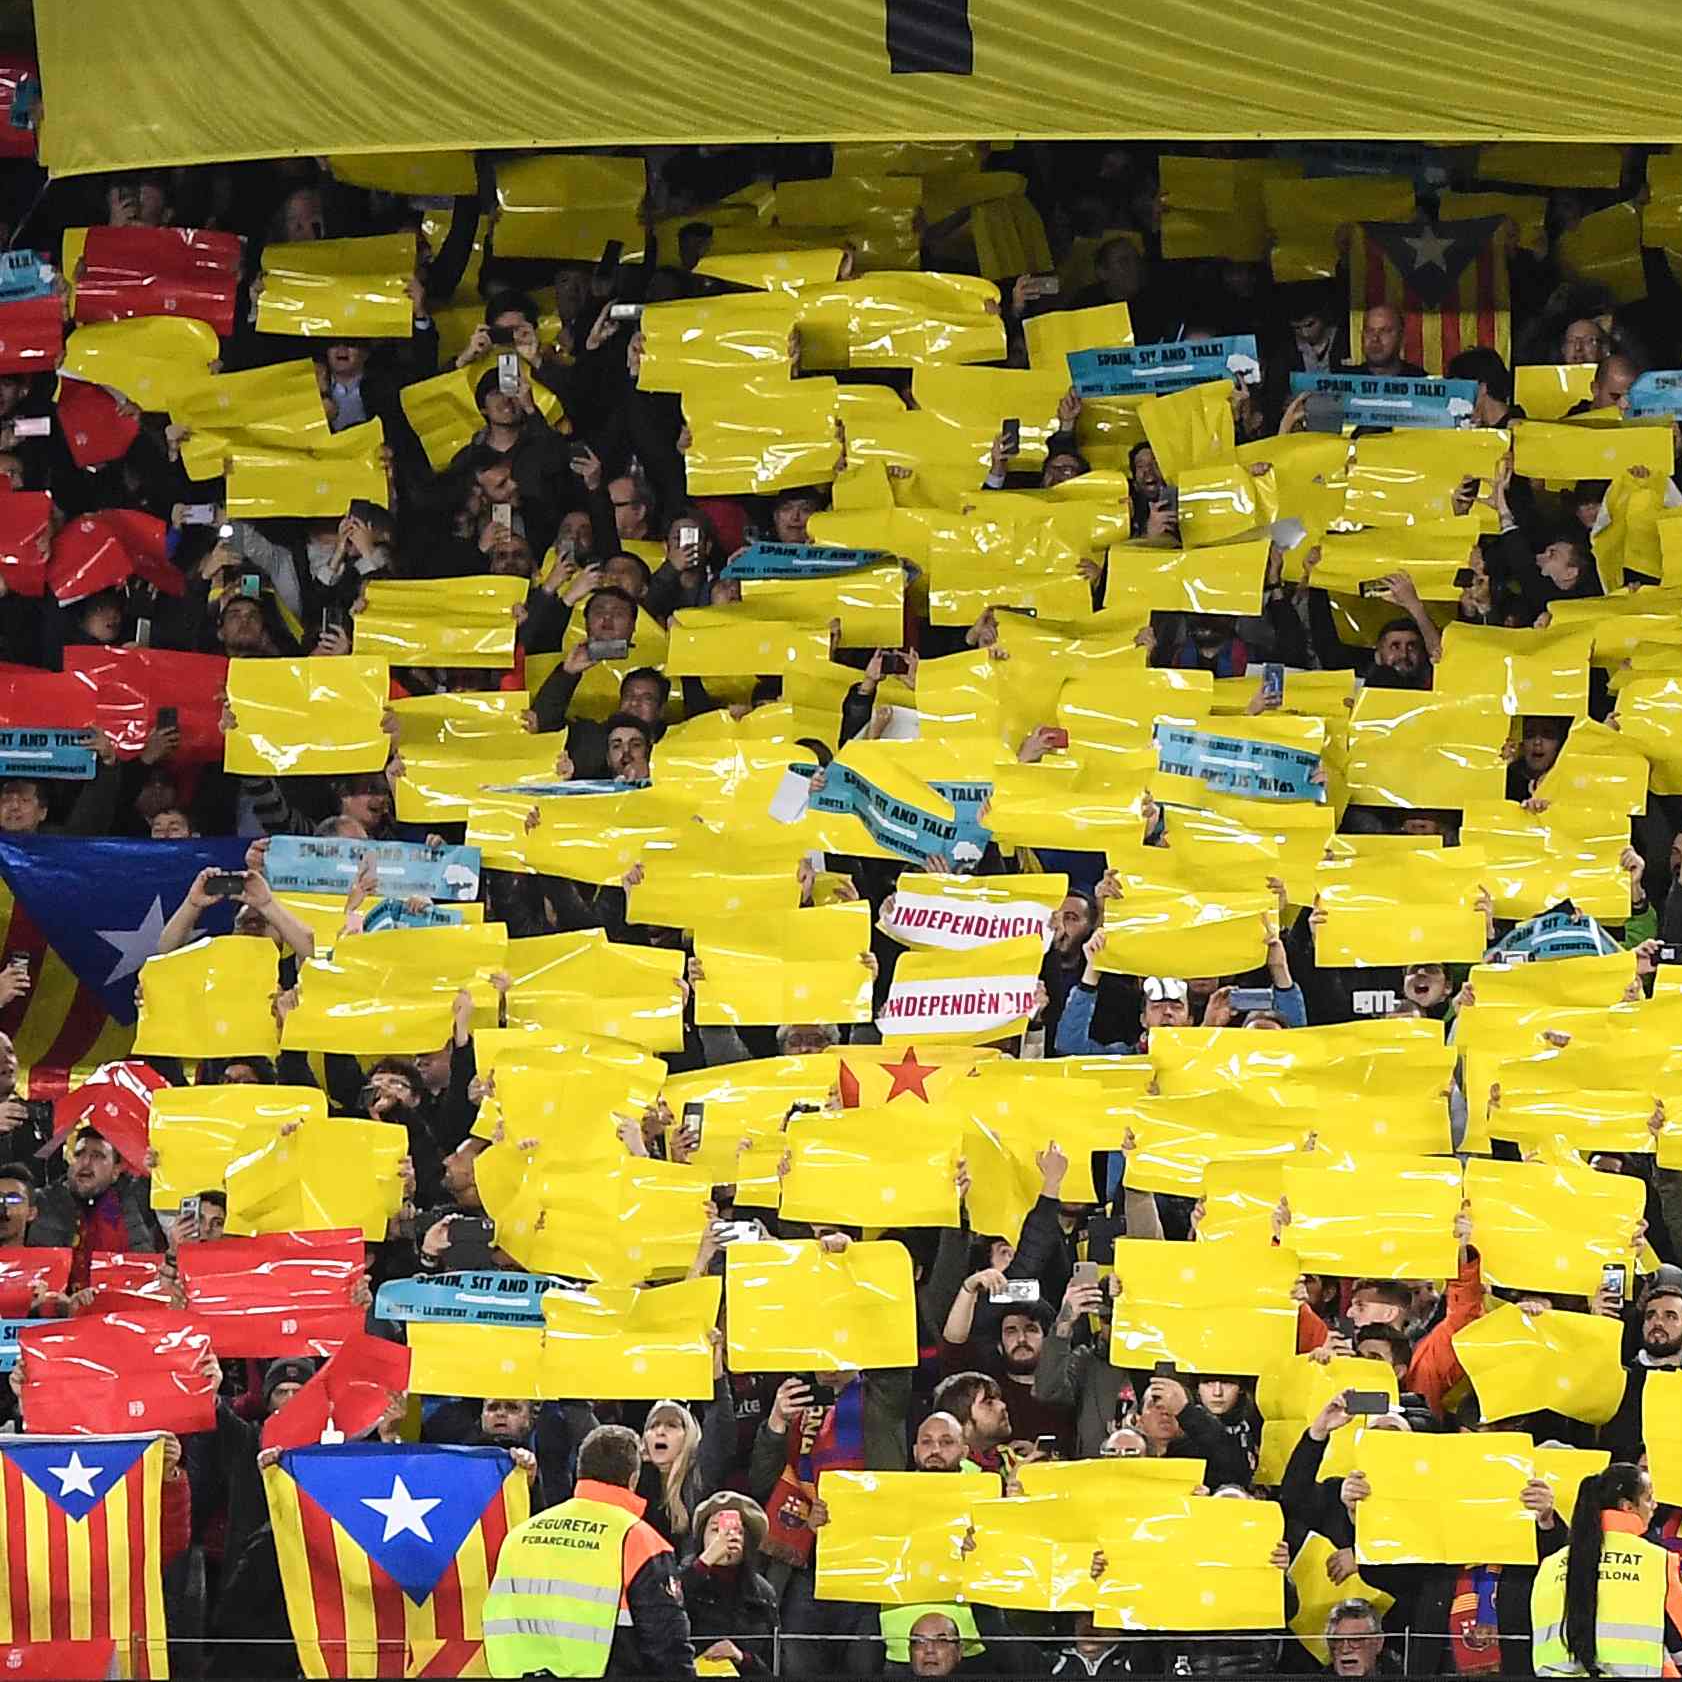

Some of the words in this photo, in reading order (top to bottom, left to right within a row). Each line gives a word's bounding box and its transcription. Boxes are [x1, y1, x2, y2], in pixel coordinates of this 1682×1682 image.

[19, 733, 48, 748] AND
[891, 805, 919, 826] AND
[925, 815, 959, 841] TALK!
[892, 906, 1045, 942] INDEPENDÈNCIA
[416, 1275, 466, 1291] SPAIN,
[470, 1275, 494, 1291] SIT
[498, 1278, 531, 1294] AND
[528, 1518, 609, 1537] SEGURETAT
